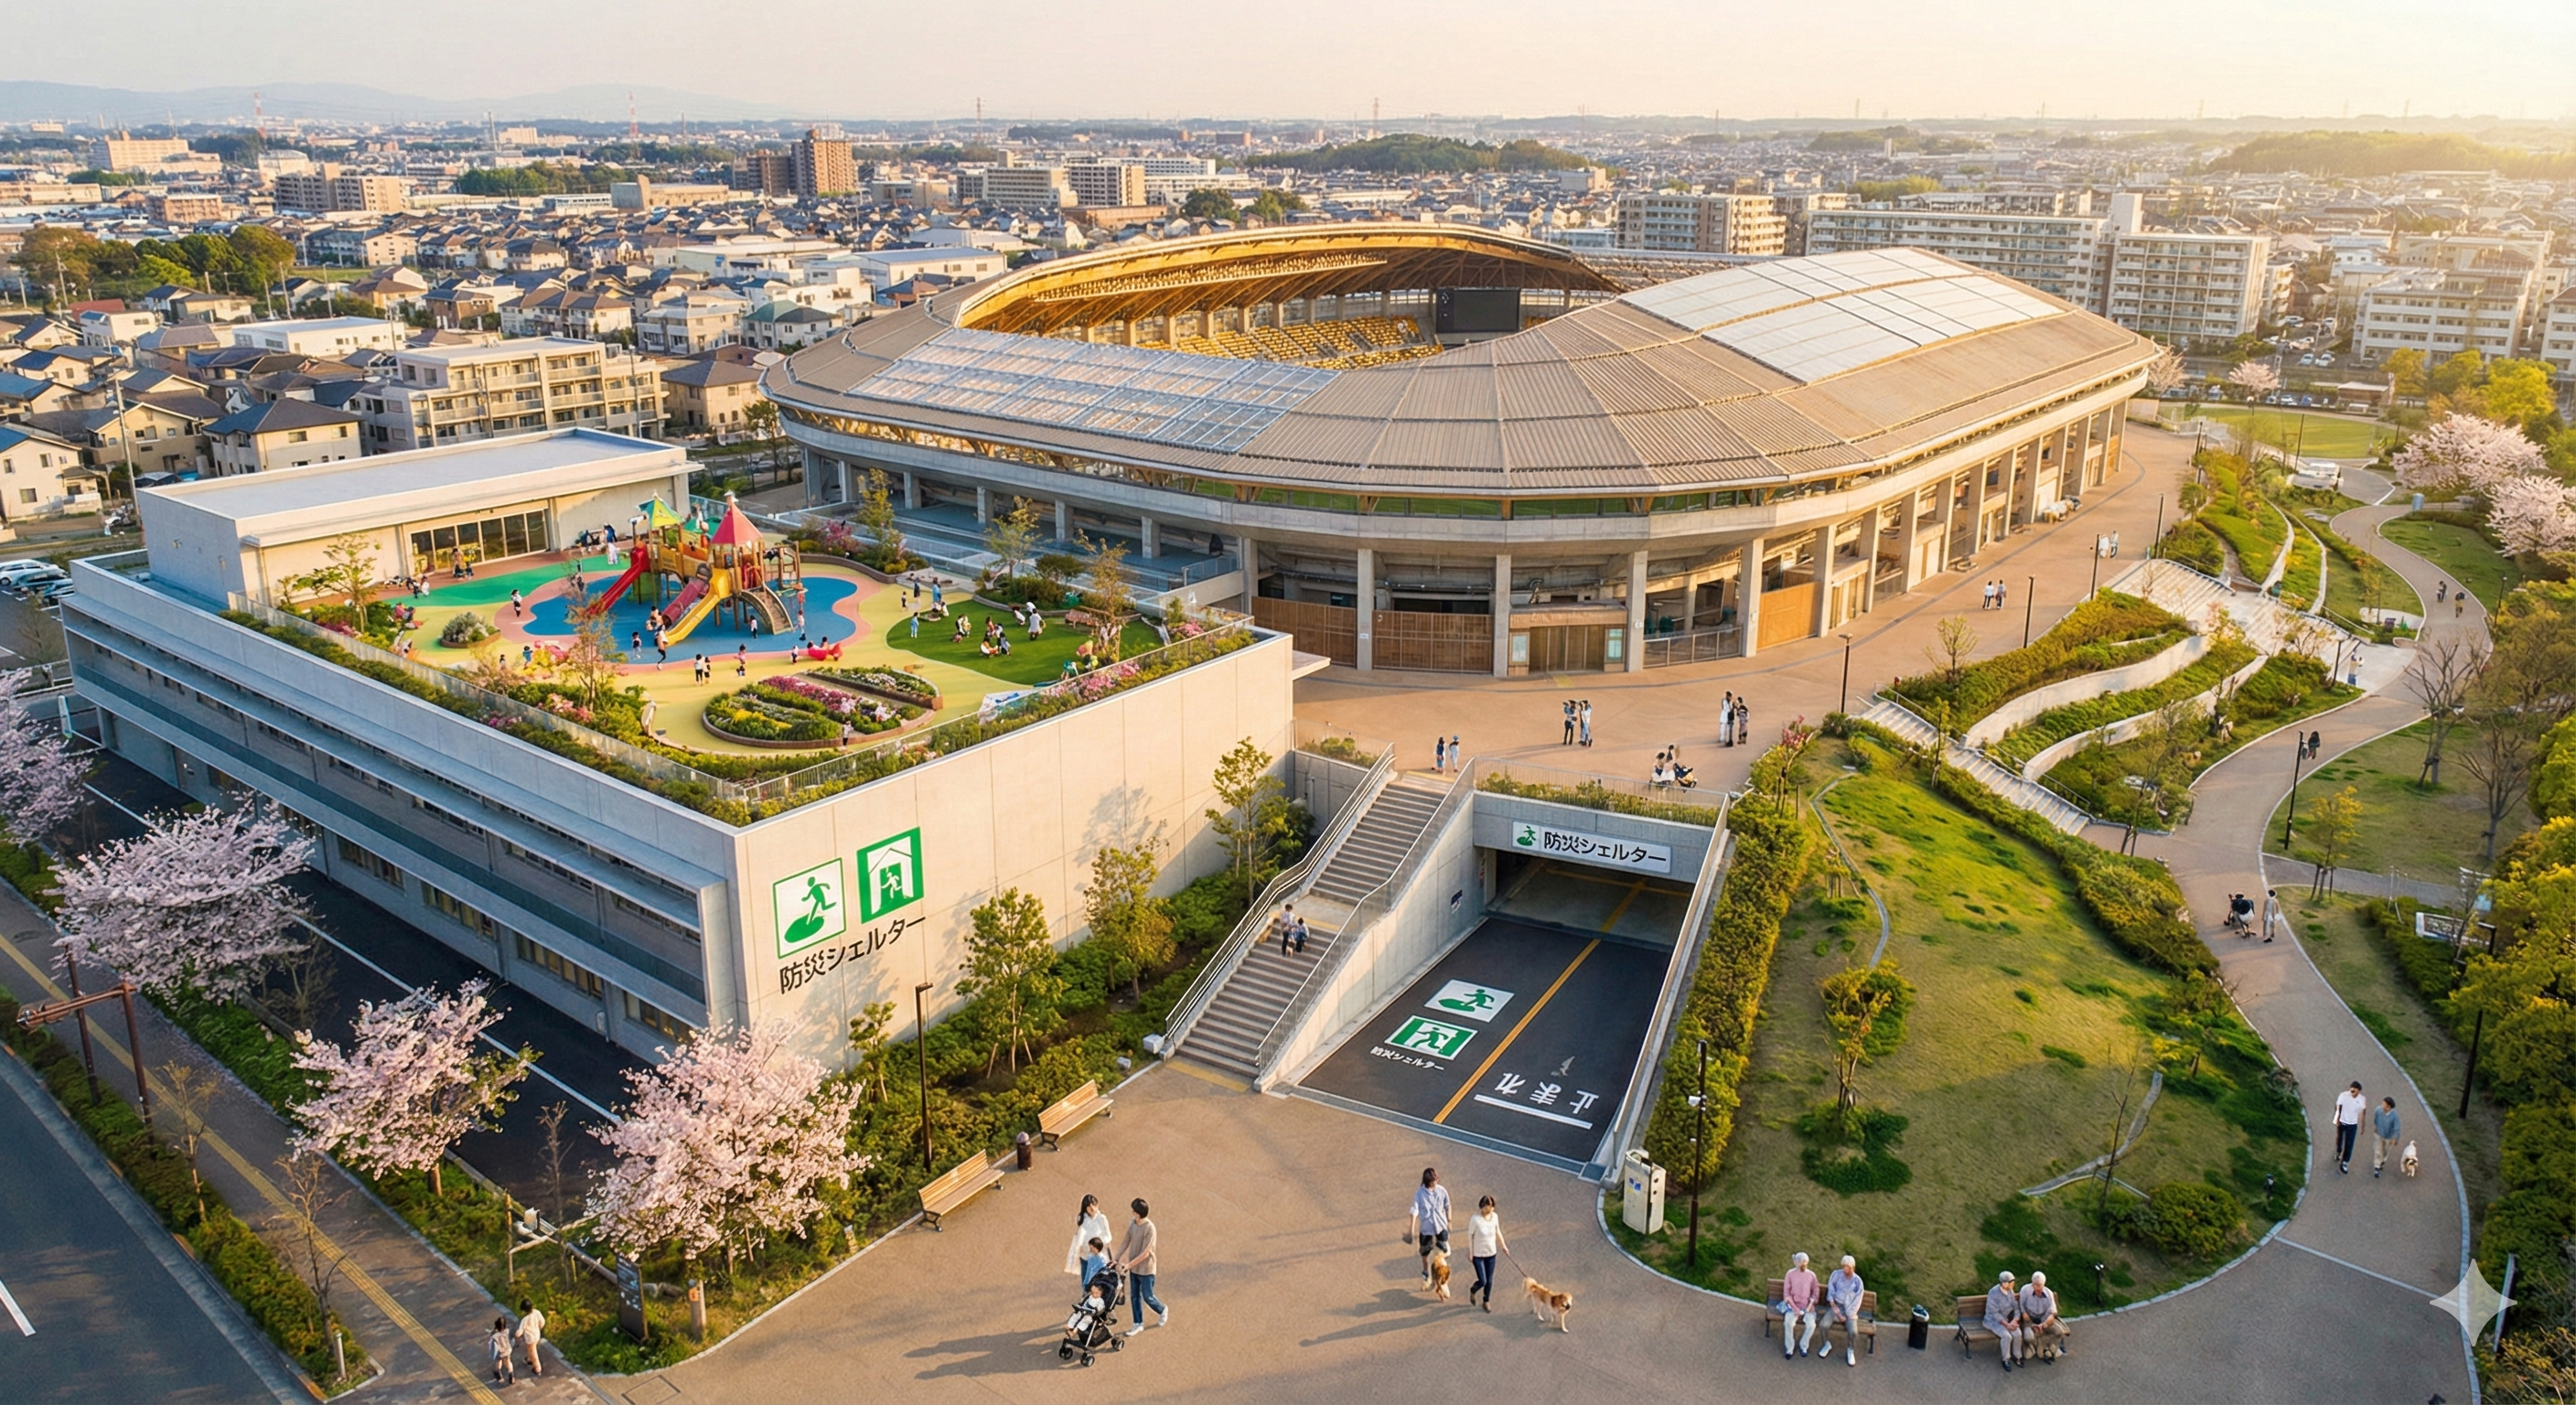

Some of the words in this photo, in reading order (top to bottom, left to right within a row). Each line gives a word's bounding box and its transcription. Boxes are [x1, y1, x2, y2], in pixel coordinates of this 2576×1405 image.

[1544, 831, 1667, 863] 防災シェルター
[779, 916, 927, 995] 防災シェルター
[1494, 1073, 1600, 1115] 止まれ
